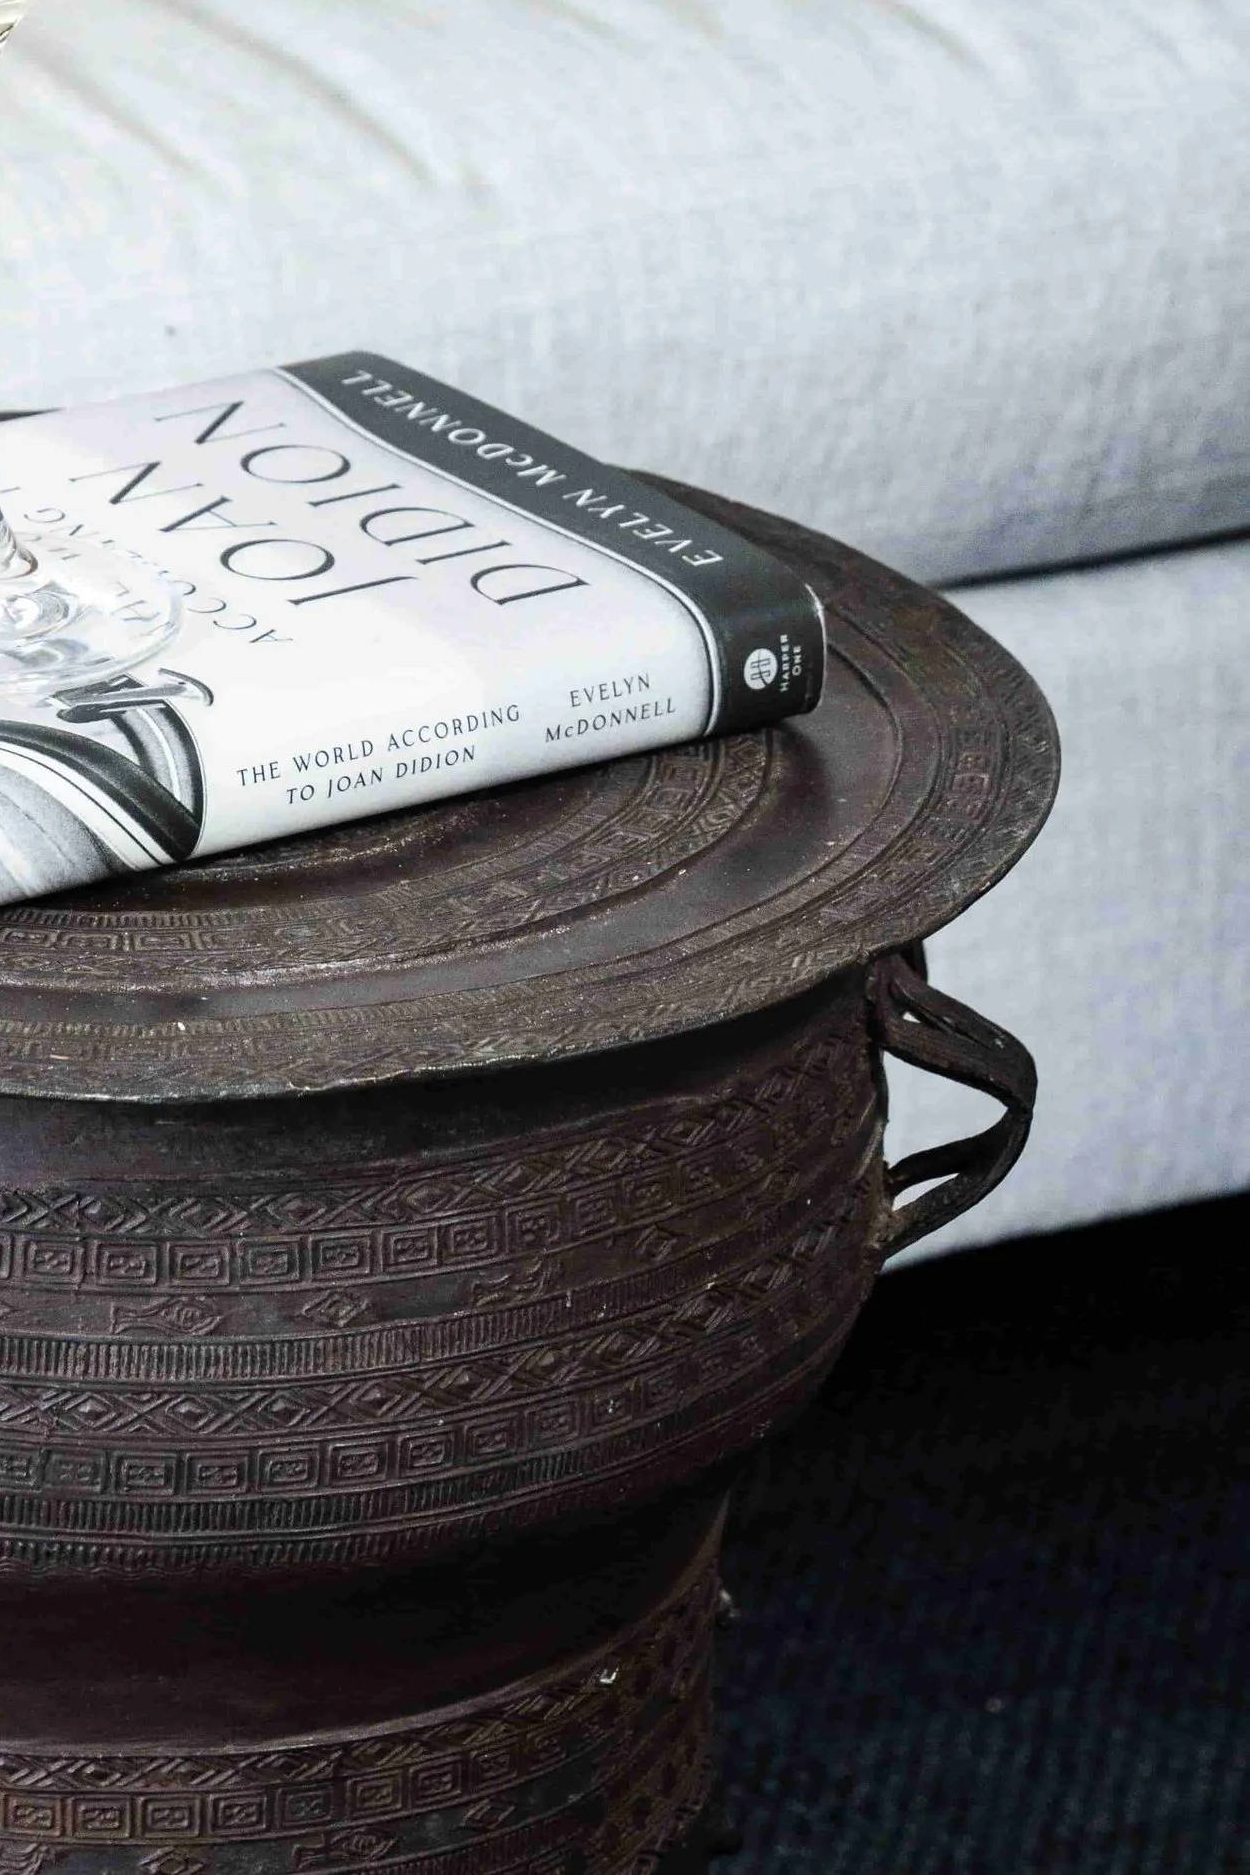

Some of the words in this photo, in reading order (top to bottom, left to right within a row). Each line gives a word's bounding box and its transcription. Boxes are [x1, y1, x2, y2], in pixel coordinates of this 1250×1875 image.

[340, 369, 567, 487] McDONNELL
[70, 461, 418, 605] JOAN
[155, 401, 591, 606] DIDION
[562, 488, 723, 568] EVELYN
[545, 697, 676, 743] McDONNELL
[569, 672, 651, 708] EVELYN
[236, 760, 281, 787] THE
[292, 739, 375, 774] WORLD
[386, 703, 521, 753] ACCORDING
[286, 783, 315, 805] TO
[326, 766, 385, 798] JOAN
[395, 744, 477, 780] DIDION
